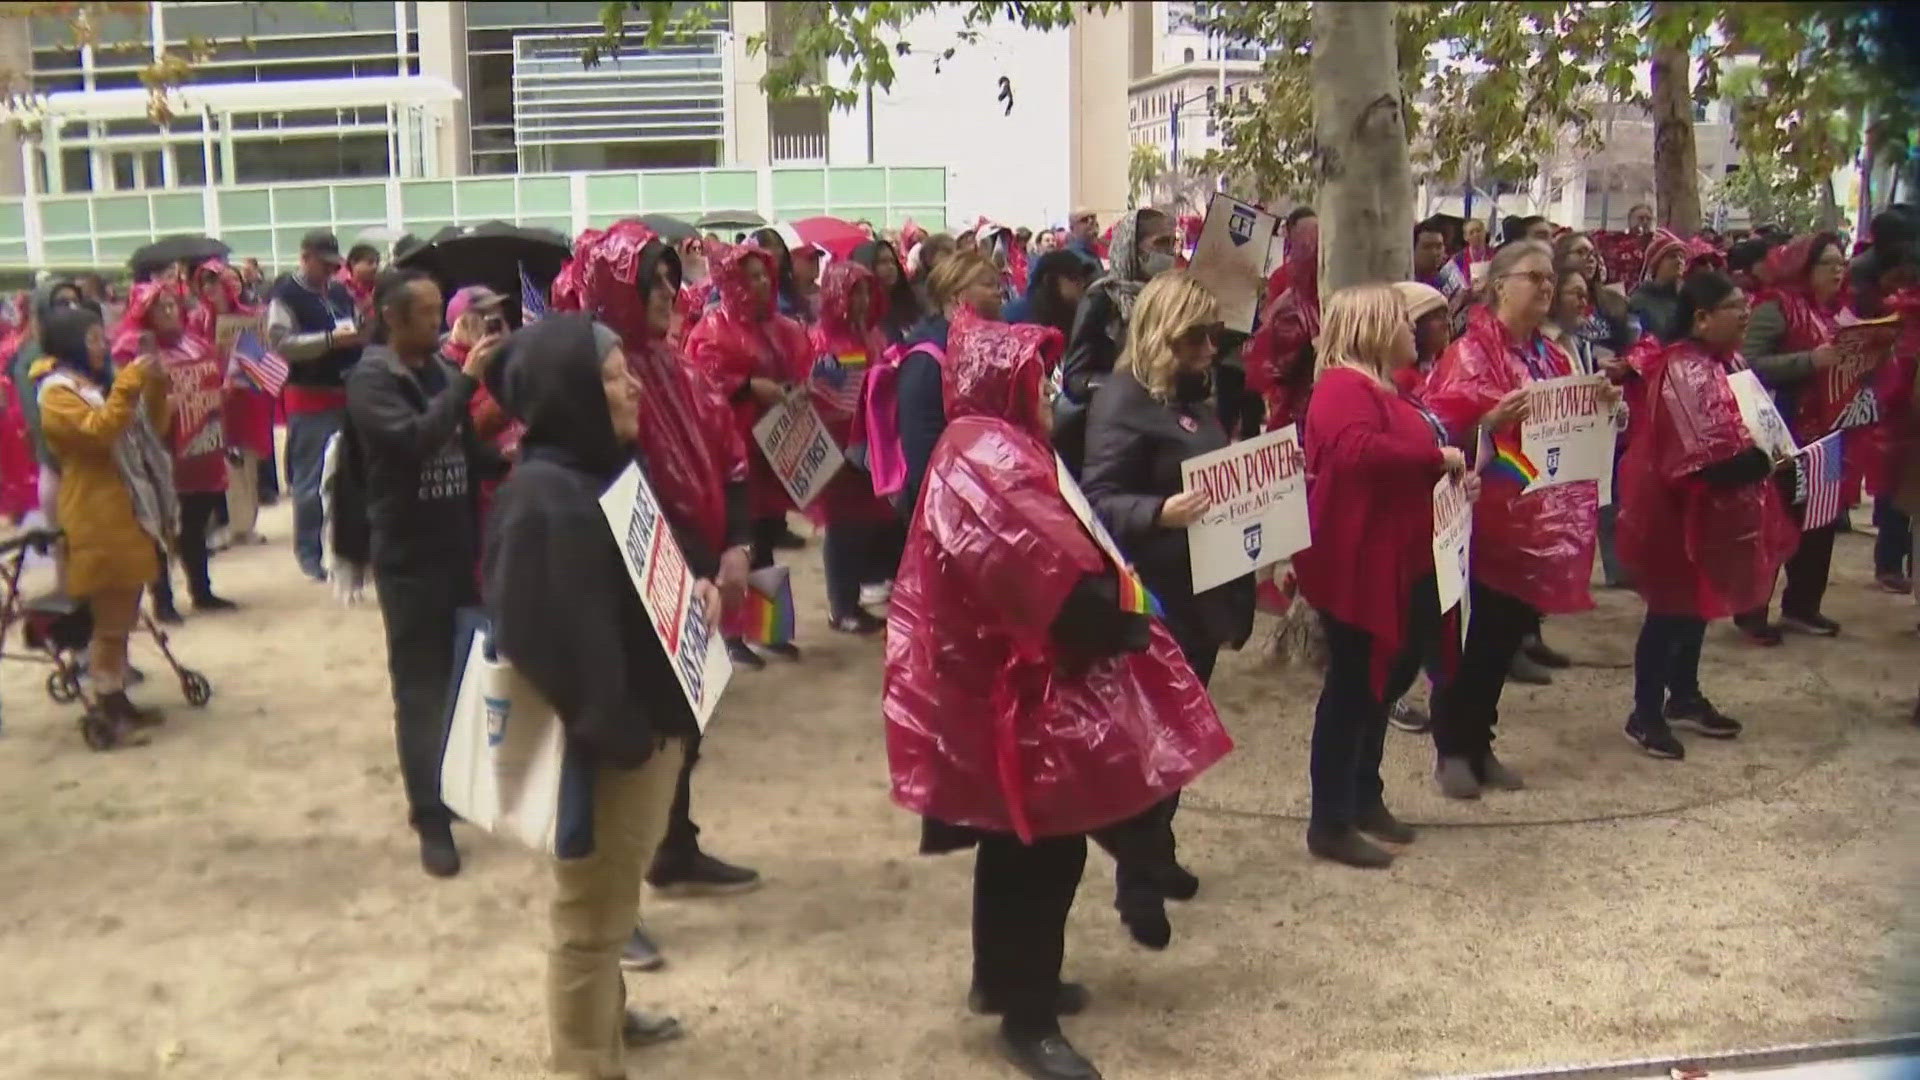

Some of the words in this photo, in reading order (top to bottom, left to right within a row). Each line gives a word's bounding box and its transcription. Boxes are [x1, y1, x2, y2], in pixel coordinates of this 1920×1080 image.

[1554, 384, 1599, 420] POWER
[789, 470, 809, 497] US
[801, 430, 829, 480] FIRST
[1243, 439, 1297, 493] POWER
[1229, 503, 1251, 520] For
[1253, 493, 1270, 511] All
[677, 639, 701, 704] US
